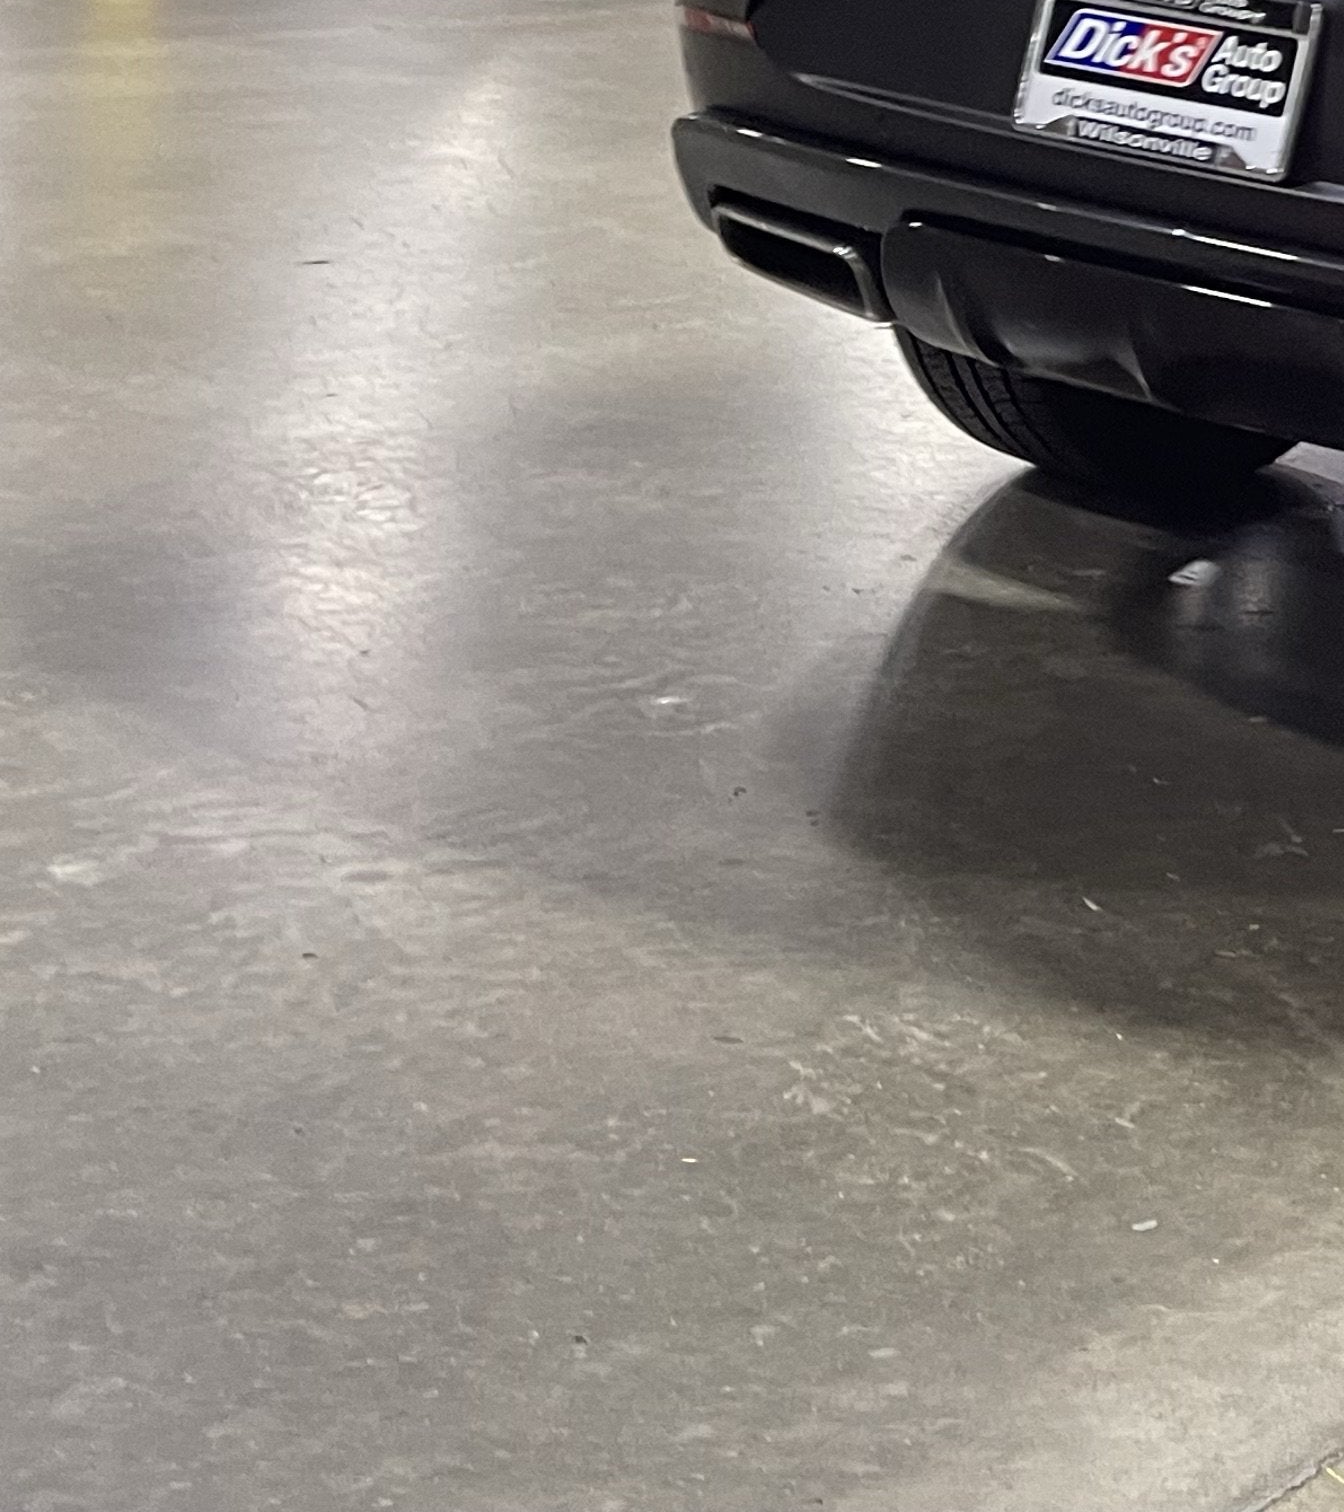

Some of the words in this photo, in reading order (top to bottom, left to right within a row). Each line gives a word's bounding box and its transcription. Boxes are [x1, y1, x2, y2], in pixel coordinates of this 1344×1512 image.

[1058, 16, 1199, 78] Dick's
[1212, 35, 1284, 73] Auto
[1201, 63, 1287, 109] Group
[1051, 87, 1258, 142] dicksautogroup.com
